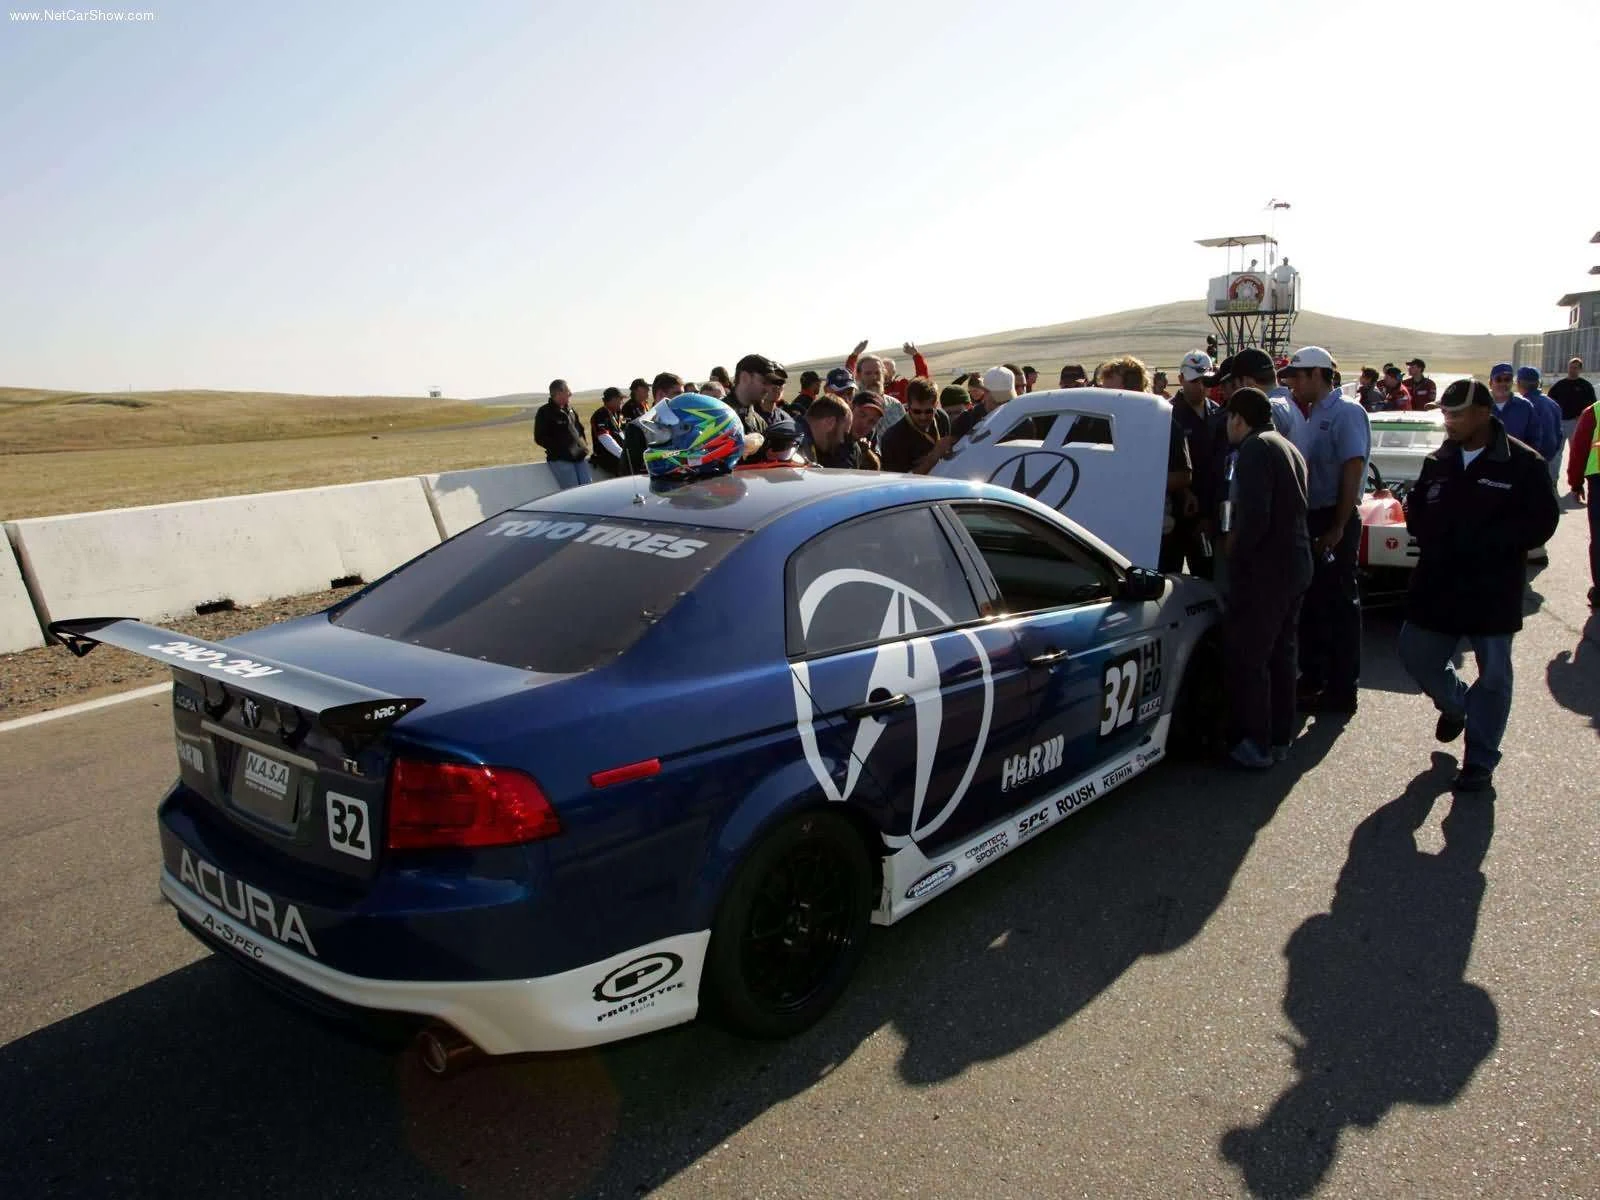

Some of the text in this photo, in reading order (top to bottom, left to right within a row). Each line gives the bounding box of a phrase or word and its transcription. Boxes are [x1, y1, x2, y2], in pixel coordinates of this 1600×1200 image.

[488, 520, 710, 559] TOYO TIRES
[1100, 660, 1138, 736] 32
[1102, 764, 1134, 789] KEIHIN
[1055, 781, 1097, 815] ROUSH
[331, 799, 365, 850] 32
[1018, 807, 1049, 833] SPC
[965, 832, 1008, 859] COMPTECH
[975, 844, 1000, 863] SPORT
[180, 848, 318, 957] ACURA
[202, 912, 265, 959] A-SPEC
[597, 982, 684, 1022] PROTOTYPE
